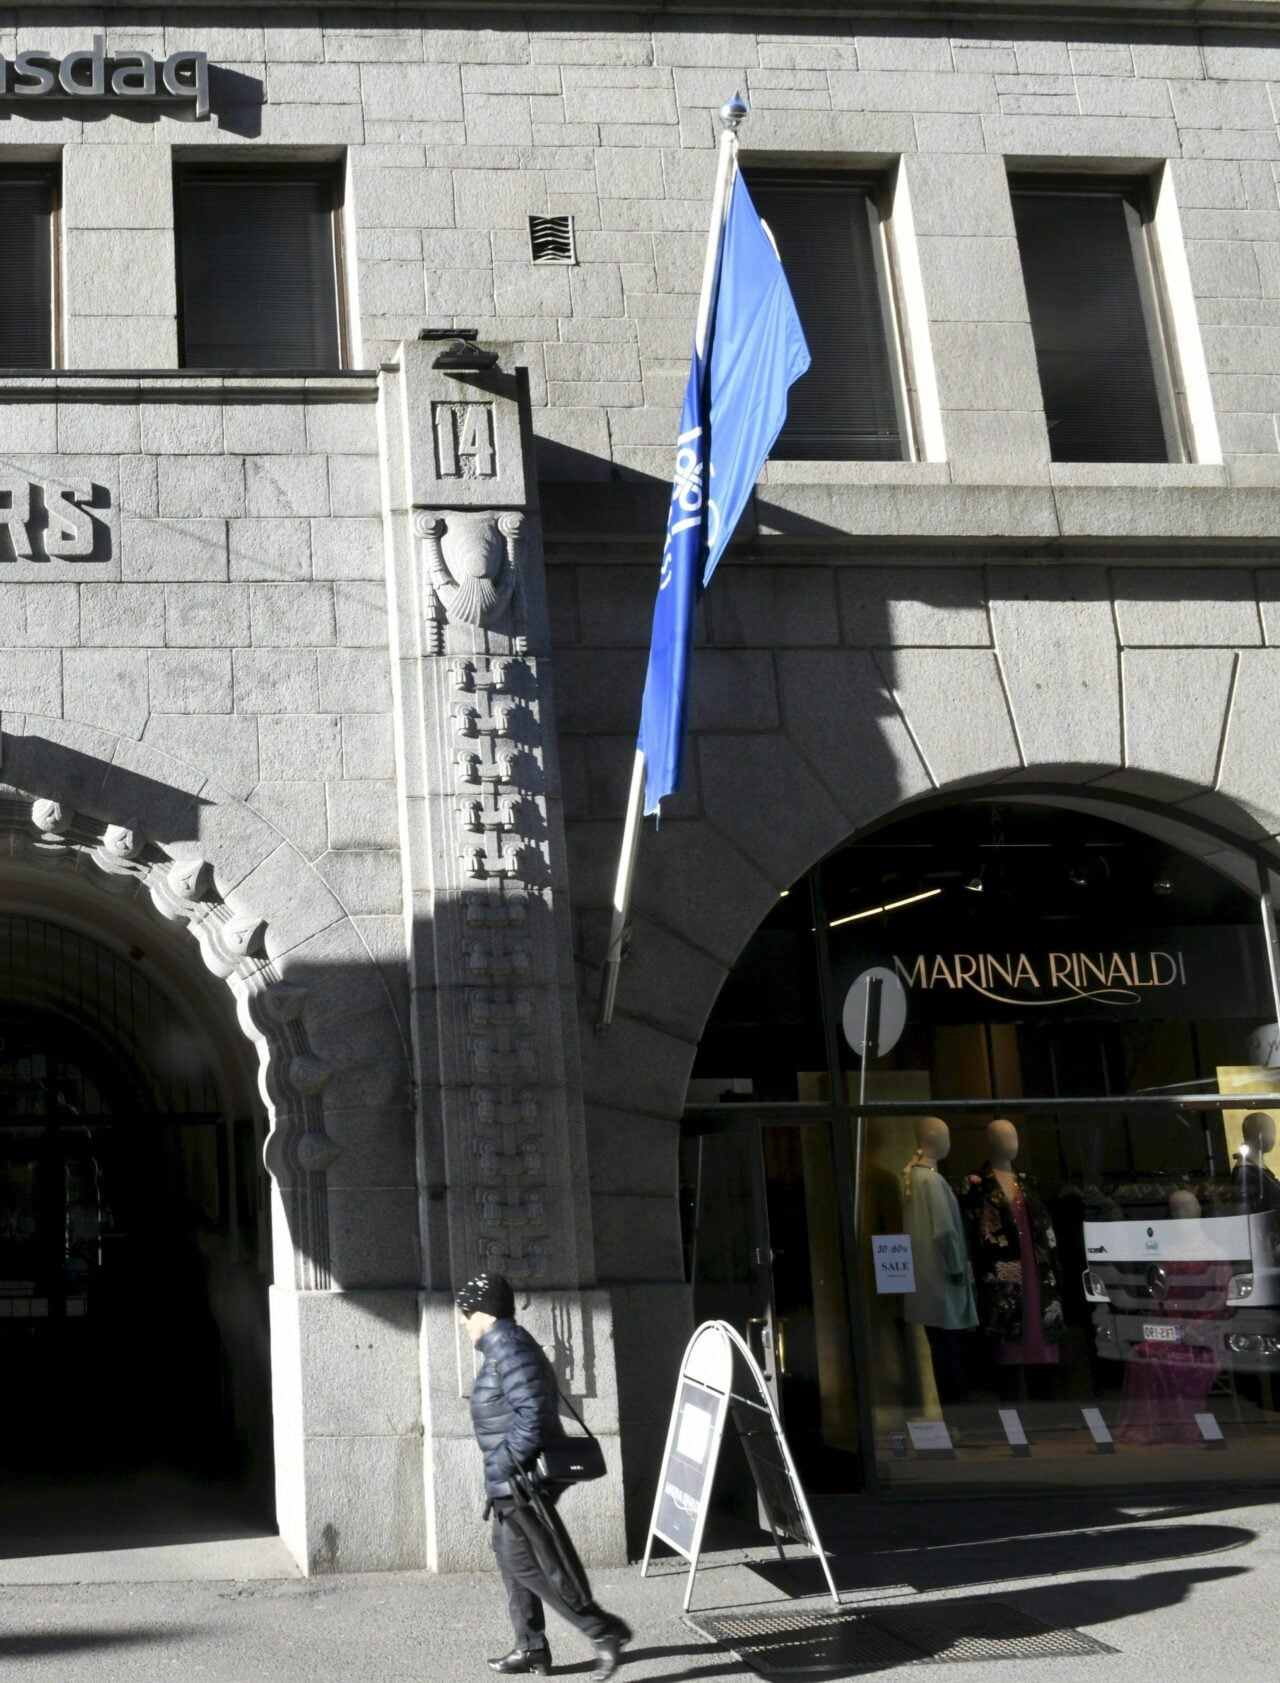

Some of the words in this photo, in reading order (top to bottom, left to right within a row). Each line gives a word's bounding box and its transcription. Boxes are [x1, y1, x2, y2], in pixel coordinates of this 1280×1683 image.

[435, 403, 495, 477] 14
[893, 952, 1040, 1006] MARINA
[1049, 951, 1187, 1006] RINALDI
[880, 1262, 910, 1271] SALE
